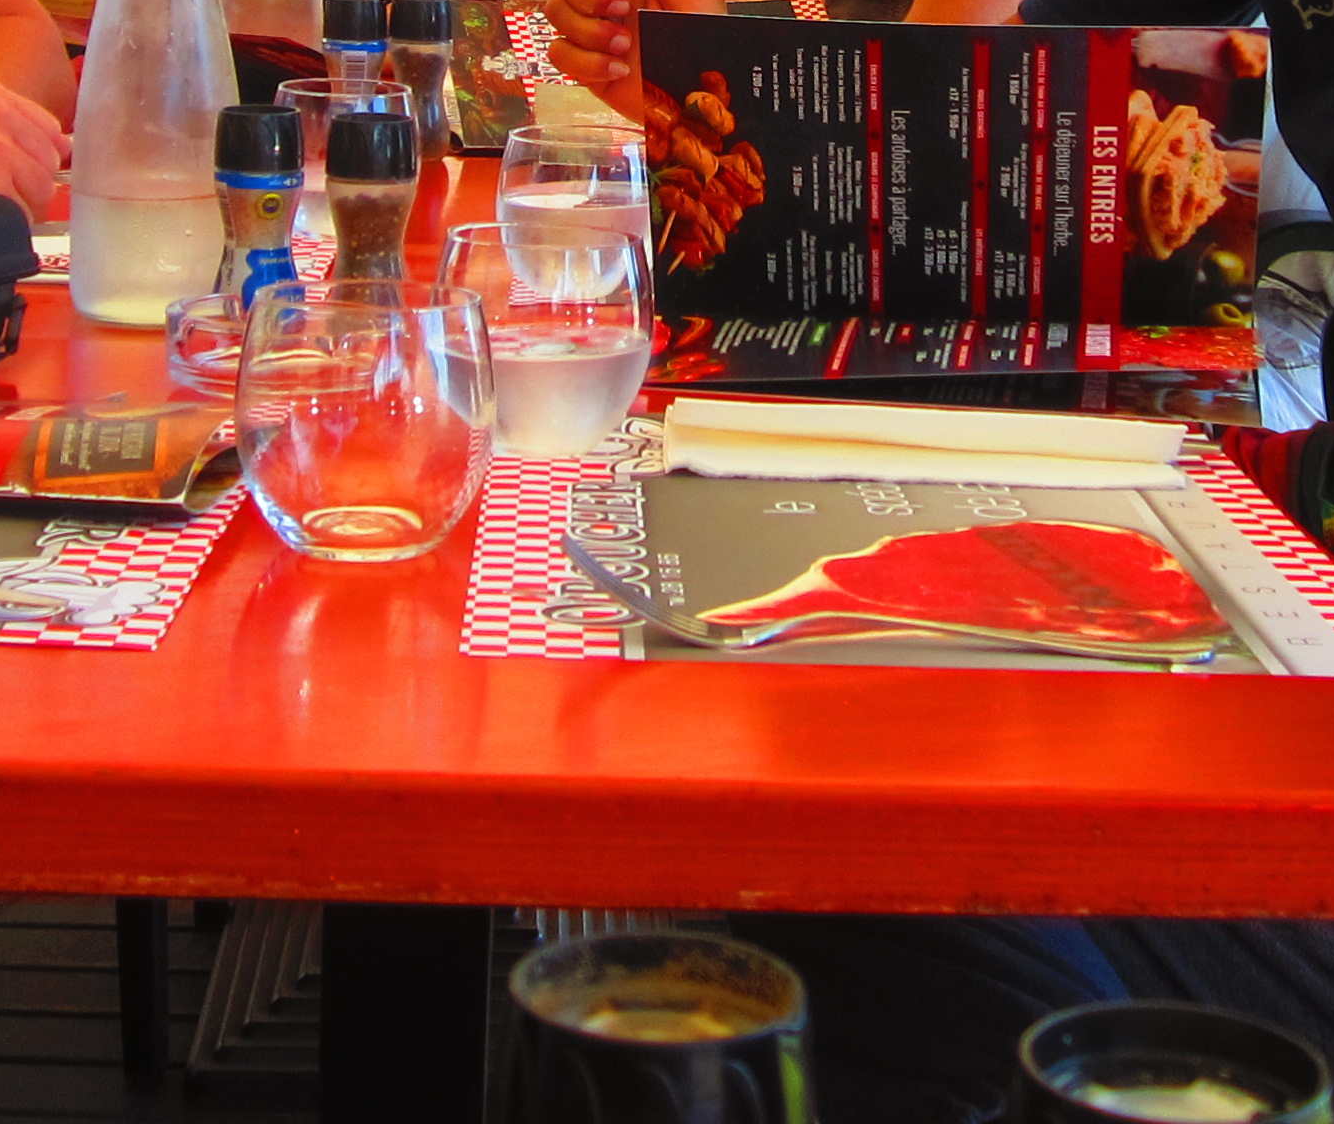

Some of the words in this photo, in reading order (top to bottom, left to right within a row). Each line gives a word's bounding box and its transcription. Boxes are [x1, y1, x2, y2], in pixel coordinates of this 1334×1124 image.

[891, 110, 911, 131] Les
[1056, 110, 1078, 126] Le
[1052, 128, 1077, 181] déjeuner
[1092, 125, 1119, 158] LES
[890, 133, 911, 184] ardoises
[891, 186, 913, 194] à
[1054, 184, 1071, 204] sur
[1089, 163, 1123, 244] ENTRÉES
